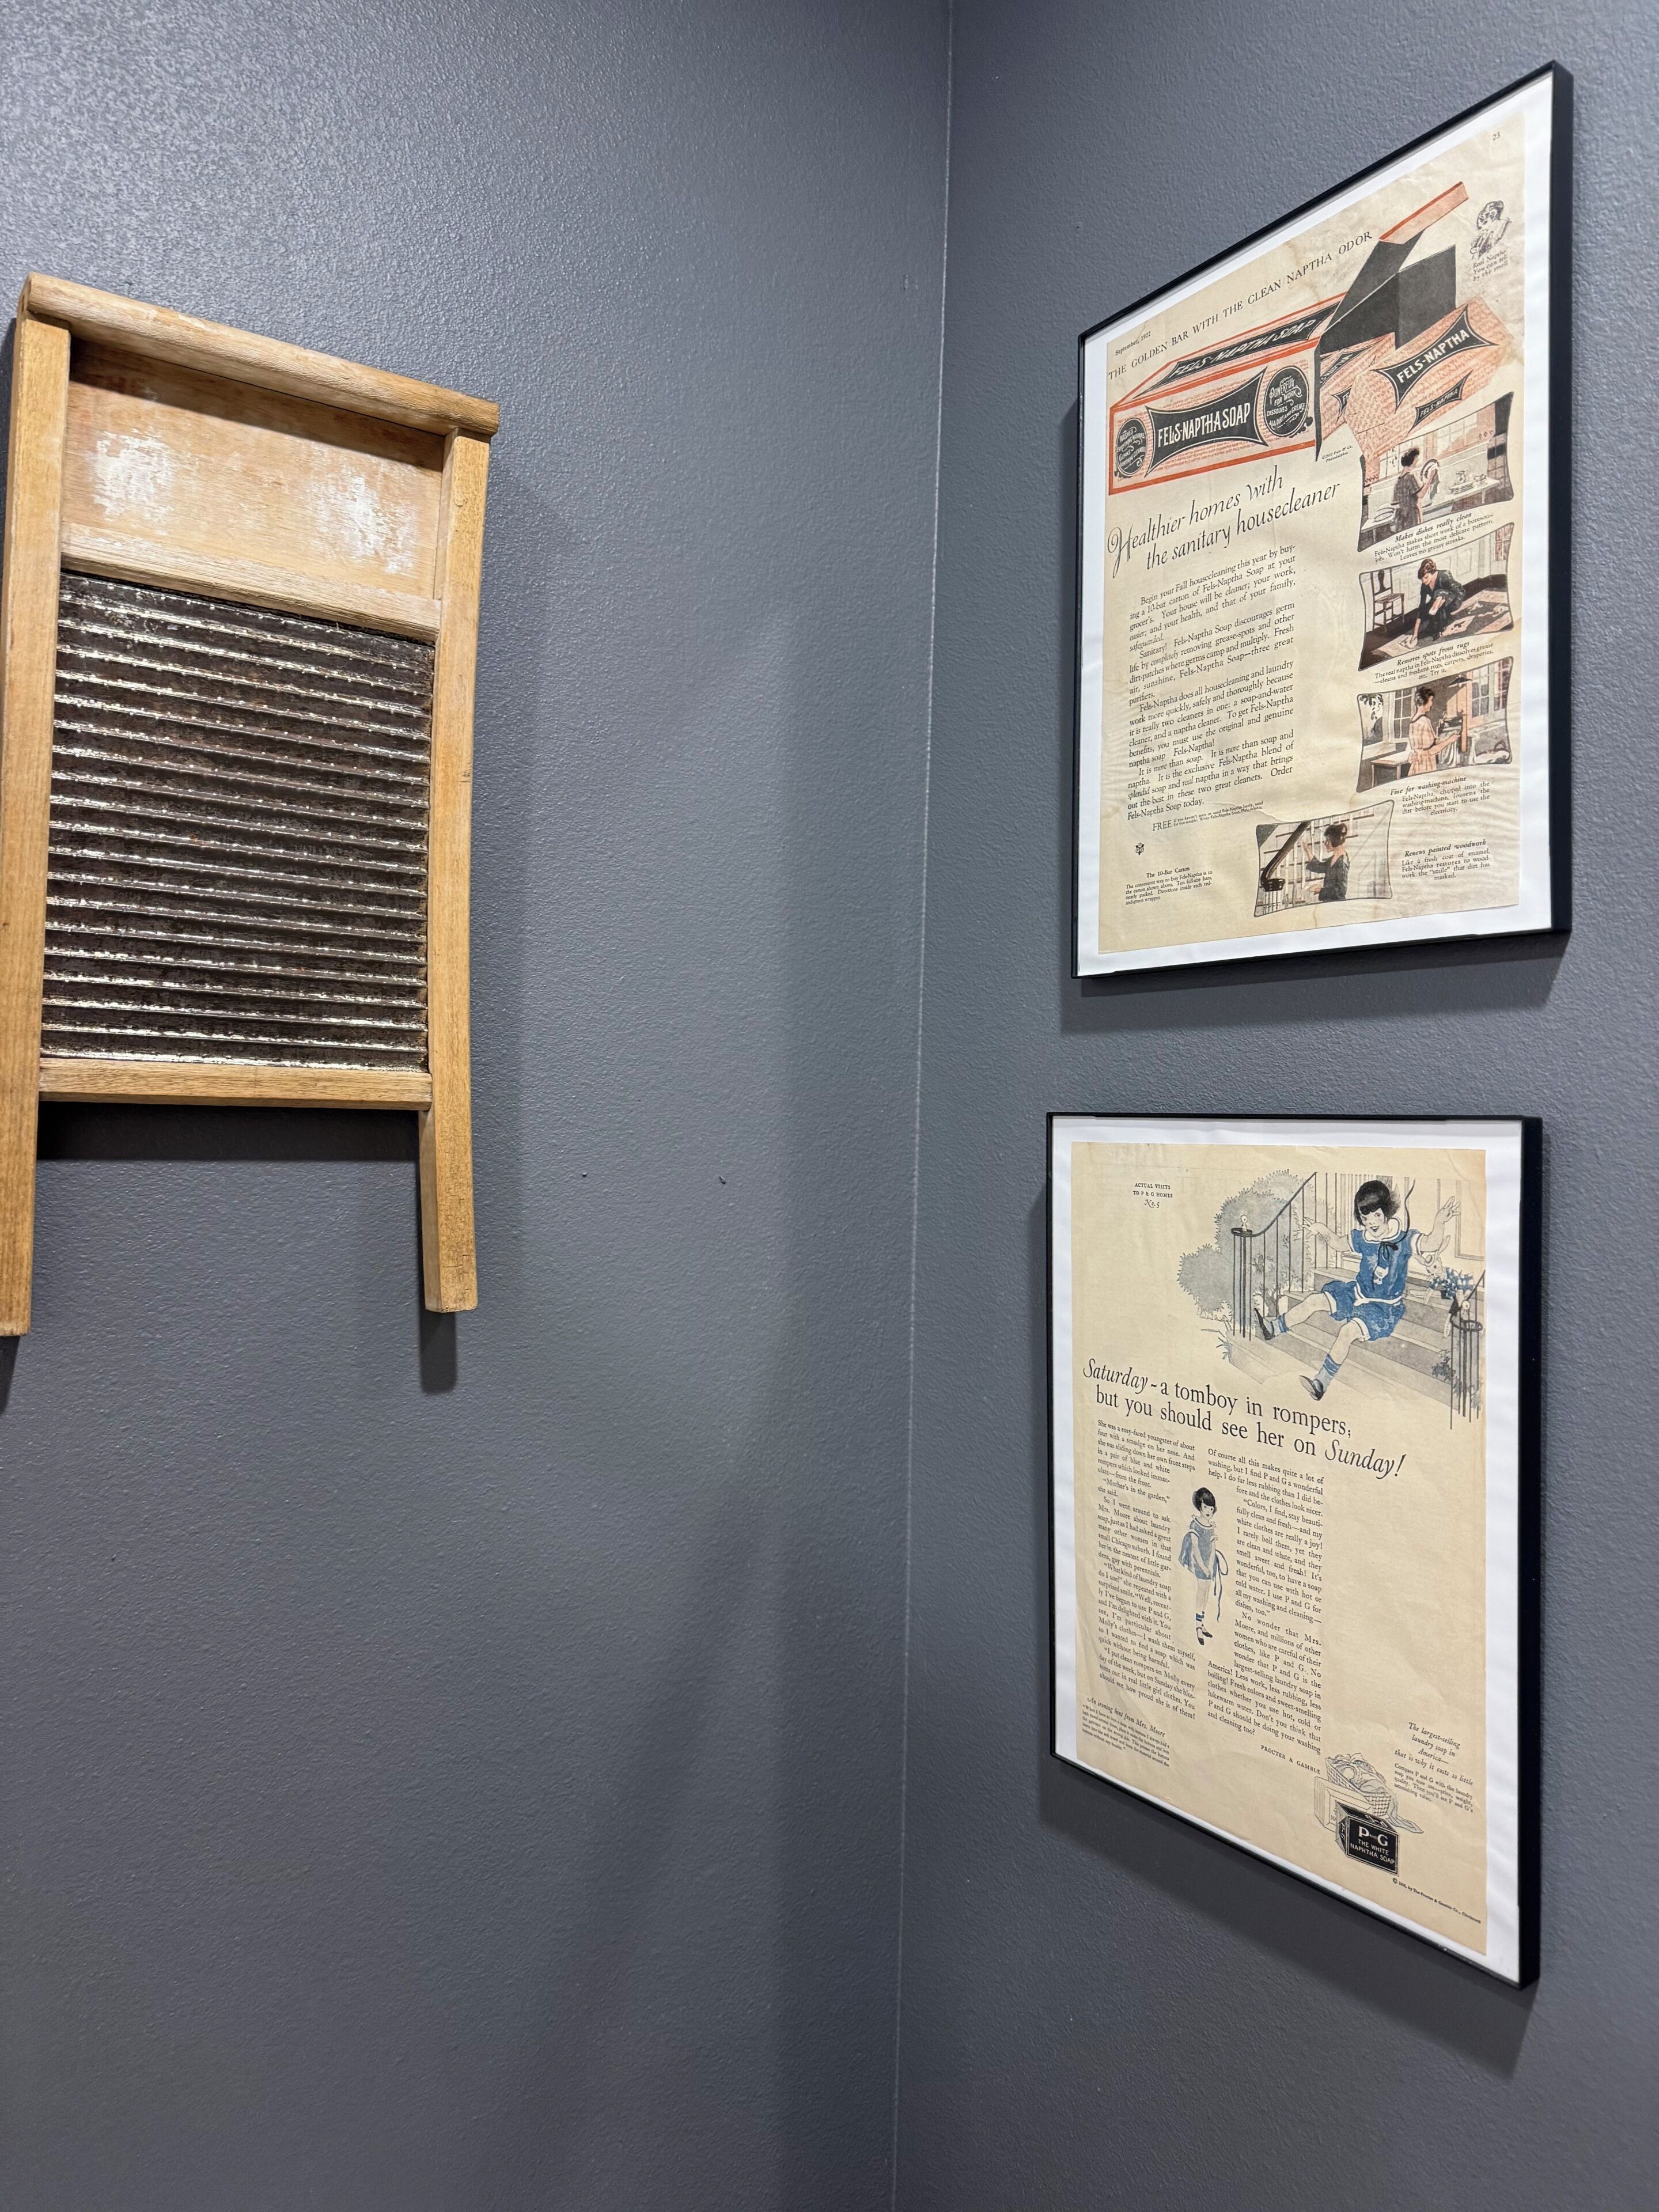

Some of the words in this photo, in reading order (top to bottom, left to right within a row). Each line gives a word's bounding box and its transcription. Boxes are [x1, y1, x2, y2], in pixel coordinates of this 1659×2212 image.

[1493, 131, 1501, 141] 23
[1108, 364, 1127, 380] THE
[1131, 341, 1168, 368] GOLDEN
[1171, 331, 1189, 346] BAR
[1192, 313, 1218, 334] WITH
[1222, 301, 1243, 317] THE
[1248, 279, 1281, 305] CLEAN
[1286, 253, 1332, 284] NAPTHA
[1338, 231, 1373, 255] ODOR
[1141, 331, 1151, 342] 1922
[1169, 334, 1275, 378] FELS-NAPTHA
[1272, 320, 1316, 342] SOAP
[1396, 329, 1470, 383] FELS-NAPTHA
[1269, 376, 1296, 404] POWERFUL
[1274, 397, 1283, 406] FOR
[1282, 389, 1302, 401] WORK
[1157, 412, 1222, 448] FELS-NAPTHA
[1222, 403, 1251, 427] SOAP
[1267, 406, 1288, 416] DISSOLVES
[1276, 415, 1285, 425] DIRT
[1291, 403, 1305, 414] GREASE
[1108, 513, 1185, 578] Healthier
[1189, 499, 1241, 525] homes
[1246, 465, 1283, 501] with
[1146, 544, 1168, 570] the
[1172, 525, 1231, 560] sanitary
[1236, 483, 1340, 535] housecleaner
[1395, 532, 1414, 543] Makes
[1416, 526, 1433, 536] dishes
[1436, 518, 1454, 529] really
[1456, 512, 1472, 522] clean
[1130, 611, 1140, 620] ing
[1147, 601, 1166, 613] 10-bar
[1169, 593, 1190, 605] carton
[1192, 585, 1200, 597] of
[1202, 573, 1243, 593] Fels-Naptha
[1246, 567, 1264, 577] Soap
[1267, 562, 1275, 570] at
[1278, 555, 1296, 569] your
[1141, 594, 1158, 605] Begin
[1160, 588, 1175, 600] your
[1175, 580, 1188, 592] Fall
[1190, 565, 1236, 587] housecleaning
[1237, 559, 1251, 570] this
[1251, 554, 1267, 566] year
[1268, 549, 1278, 559] by
[1279, 544, 1296, 555] buy-
[1161, 608, 1177, 619] Your
[1179, 601, 1198, 612] house
[1199, 593, 1212, 604] will
[1214, 591, 1222, 600] be
[1253, 575, 1271, 588] your
[1397, 655, 1421, 666] Removes
[1422, 650, 1436, 660] spots
[1438, 646, 1453, 656] from
[1457, 641, 1469, 649] rugs
[1405, 786, 1415, 795] for
[1418, 774, 1467, 790] washing-machine
[1127, 805, 1164, 820] Fels-Naptha
[1165, 803, 1181, 812] Soap
[1183, 797, 1205, 808] today.
[1152, 820, 1172, 832] FREE
[1427, 843, 1452, 856] painted
[1453, 838, 1487, 849] woodwork
[1083, 1358, 1148, 1395] Saturday
[1160, 1381, 1169, 1396] a
[1175, 1381, 1238, 1415] tomboy
[1246, 1396, 1263, 1416] in
[1272, 1406, 1352, 1438] rompers;
[1096, 1384, 1119, 1408] but
[1124, 1398, 1153, 1417] you
[1160, 1401, 1213, 1431] should
[1221, 1422, 1248, 1439] see
[1256, 1422, 1285, 1448] her
[1294, 1438, 1316, 1456] on
[1324, 1439, 1407, 1480] Sunday!
[1207, 1448, 1217, 1457] Of
[1218, 1452, 1236, 1461] course
[1238, 1456, 1246, 1464] all
[1248, 1458, 1260, 1467] this
[1262, 1463, 1281, 1473] makes
[1282, 1468, 1298, 1478] quite
[1305, 1473, 1315, 1482] lot
[1317, 1476, 1325, 1484] of
[1233, 1464, 1244, 1474] but
[1250, 1468, 1262, 1479] find
[1281, 1477, 1287, 1485] G
[1293, 1482, 1323, 1495] wonderful
[1207, 1660, 1233, 1676] America!
[1235, 1670, 1248, 1682] Less
[1250, 1678, 1267, 1691] work,
[1269, 1684, 1281, 1694] less
[1282, 1691, 1308, 1707] rubbing,
[1310, 1699, 1321, 1710] less
[1086, 1697, 1097, 1705] An
[1097, 1700, 1113, 1714] ironing
[1114, 1707, 1123, 1717] hint
[1123, 1713, 1135, 1723] from
[1149, 1725, 1165, 1737] Moore
[1408, 1721, 1419, 1732] The
[1421, 1727, 1461, 1750] largest-selling
[1411, 1733, 1434, 1749] laundry
[1435, 1745, 1448, 1755] soap
[1449, 1748, 1456, 1757] in
[1260, 1744, 1286, 1760] PROCTER
[1296, 1760, 1320, 1775] GAMBLE
[1394, 1749, 1407, 1759] that
[1414, 1758, 1427, 1769] why
[1436, 1767, 1449, 1777] costs
[1459, 1775, 1474, 1786] little
[1358, 1825, 1370, 1838] P
[1377, 1834, 1388, 1847] G
[1358, 1839, 1369, 1848] THE
[1370, 1844, 1389, 1855] WHITE
[1350, 1843, 1378, 1858] NAPHTHA
[1380, 1854, 1396, 1869] SOAP
